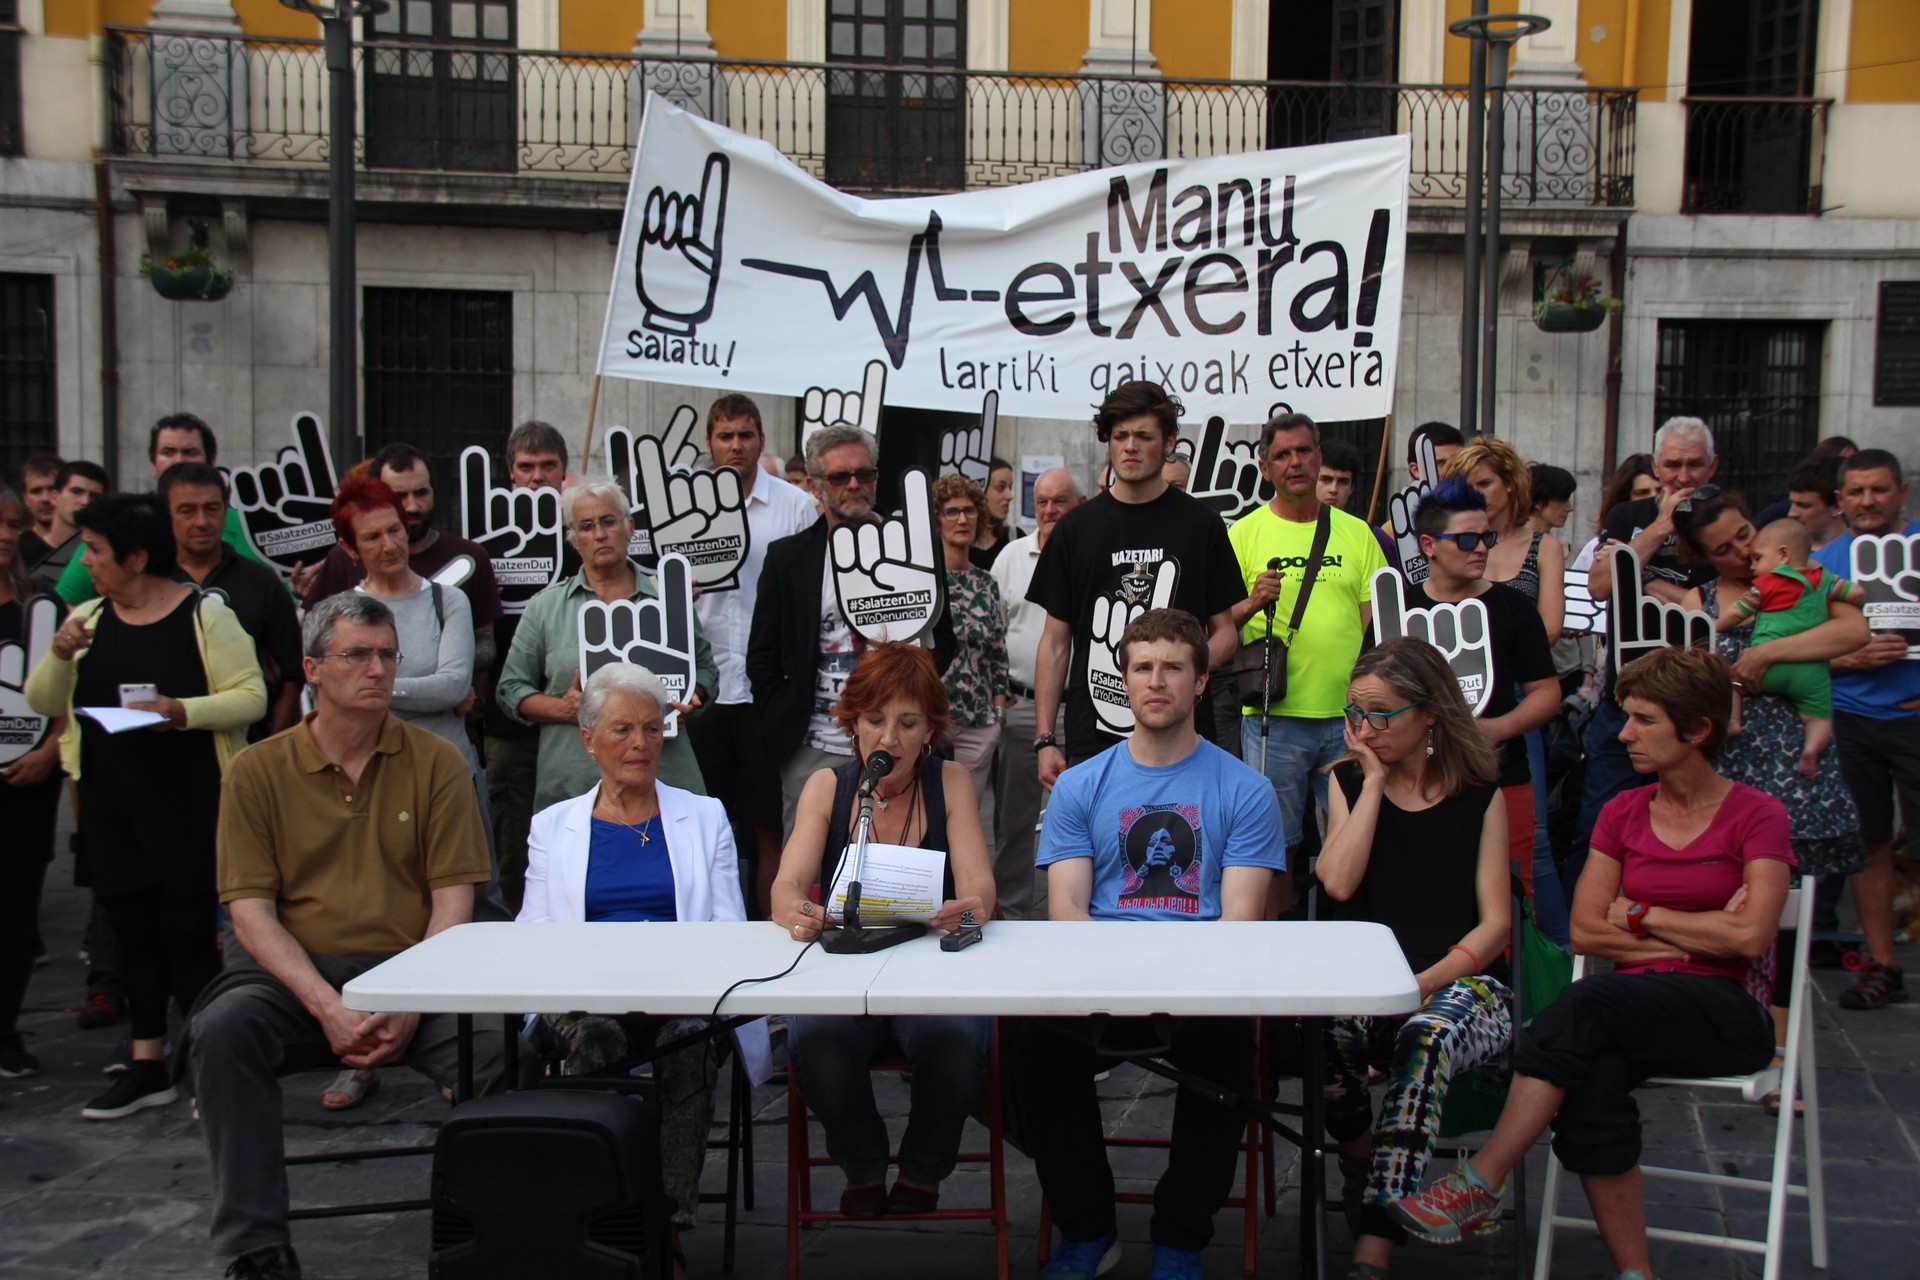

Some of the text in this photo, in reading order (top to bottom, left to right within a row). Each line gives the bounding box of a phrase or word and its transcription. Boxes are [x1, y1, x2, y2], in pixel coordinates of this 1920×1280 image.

[1107, 167, 1301, 254] Manu
[1004, 208, 1391, 348] etxera!
[625, 329, 737, 377] Salatu!
[1089, 348, 1251, 409] gaixoak
[1268, 339, 1383, 390] etxera
[258, 521, 336, 543] #SalatzenDut
[267, 535, 335, 554] #YoDenuncio
[663, 537, 741, 555] #SalatzenDut
[689, 551, 738, 566] Denuncio
[1111, 548, 1164, 567] KAZETARI
[499, 574, 548, 584] Denuncio
[849, 592, 930, 612] #SalatzenDut
[856, 608, 927, 625] #YoDenuncio
